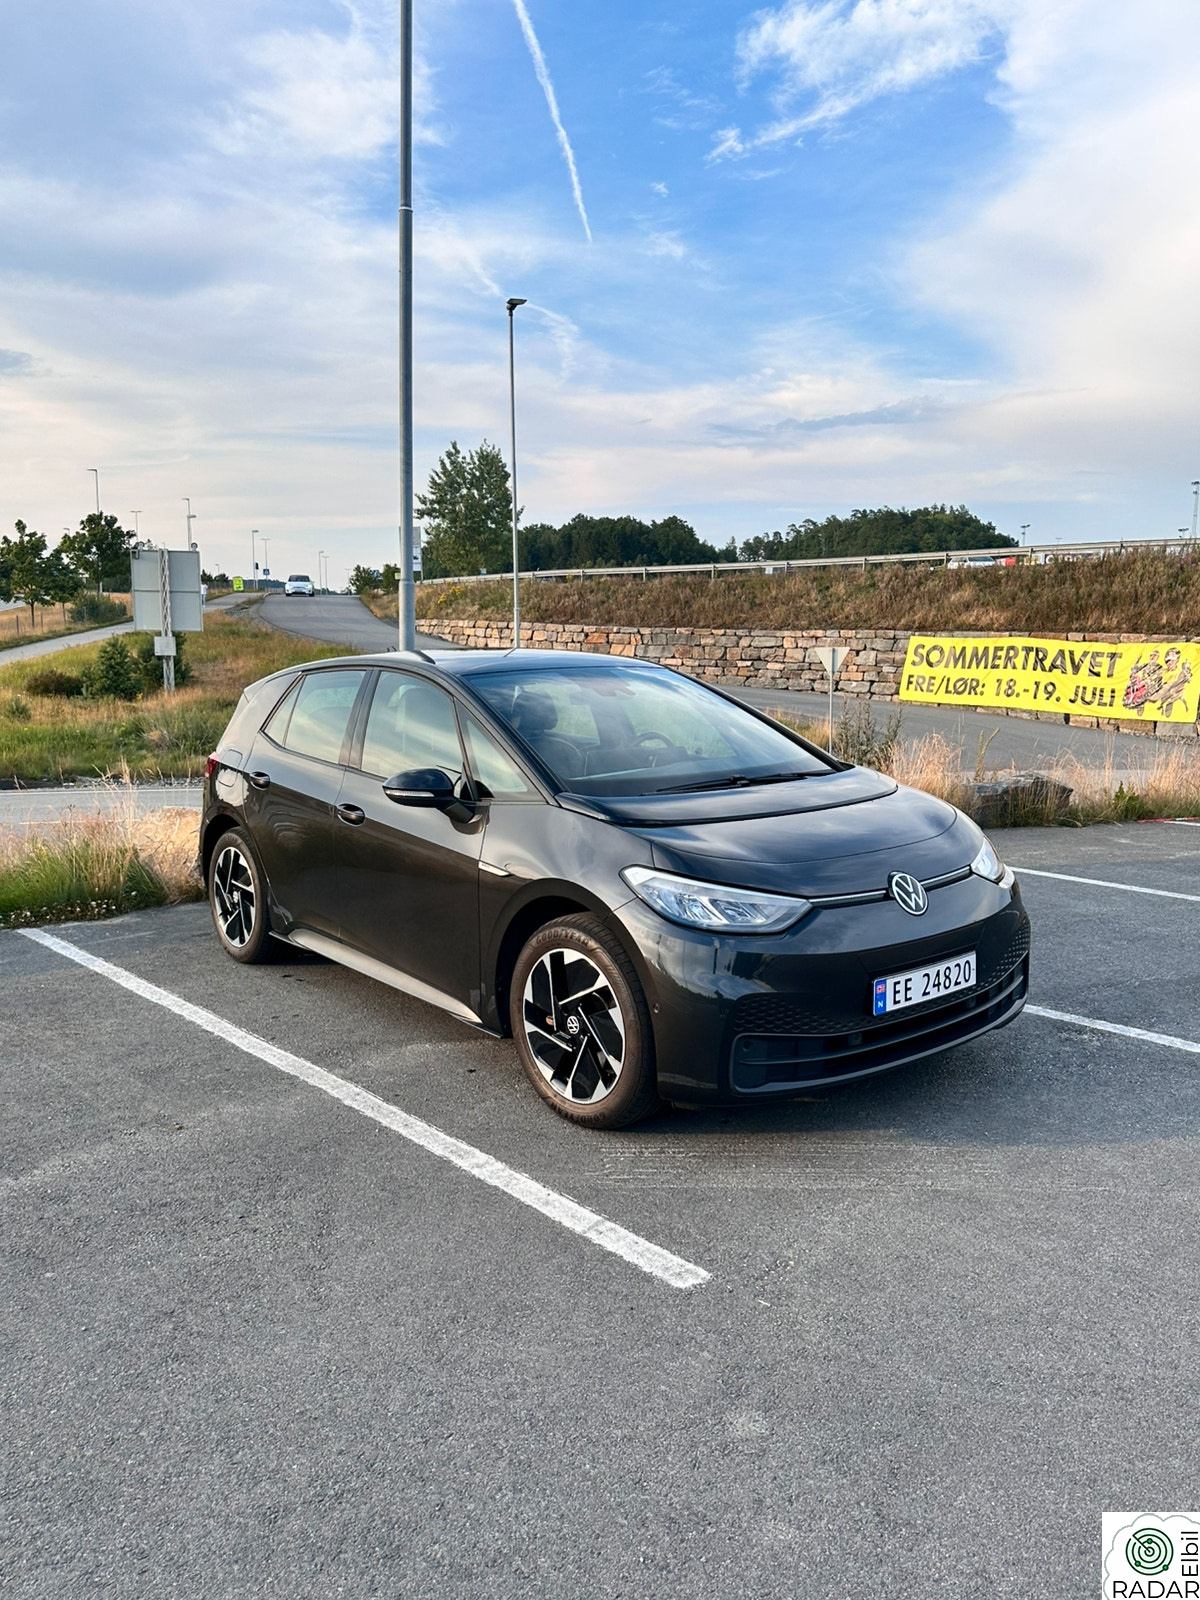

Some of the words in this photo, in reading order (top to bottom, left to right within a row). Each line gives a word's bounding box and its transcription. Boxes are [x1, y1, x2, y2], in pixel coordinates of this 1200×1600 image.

[910, 644, 1122, 678] SOMMERTRAVET
[906, 674, 985, 698] FRE/LØR:
[995, 678, 1061, 702] 18.-19.
[1069, 685, 1116, 708] JULI
[893, 977, 912, 1005] EE
[922, 959, 971, 997] 24820
[877, 1000, 884, 1008] N
